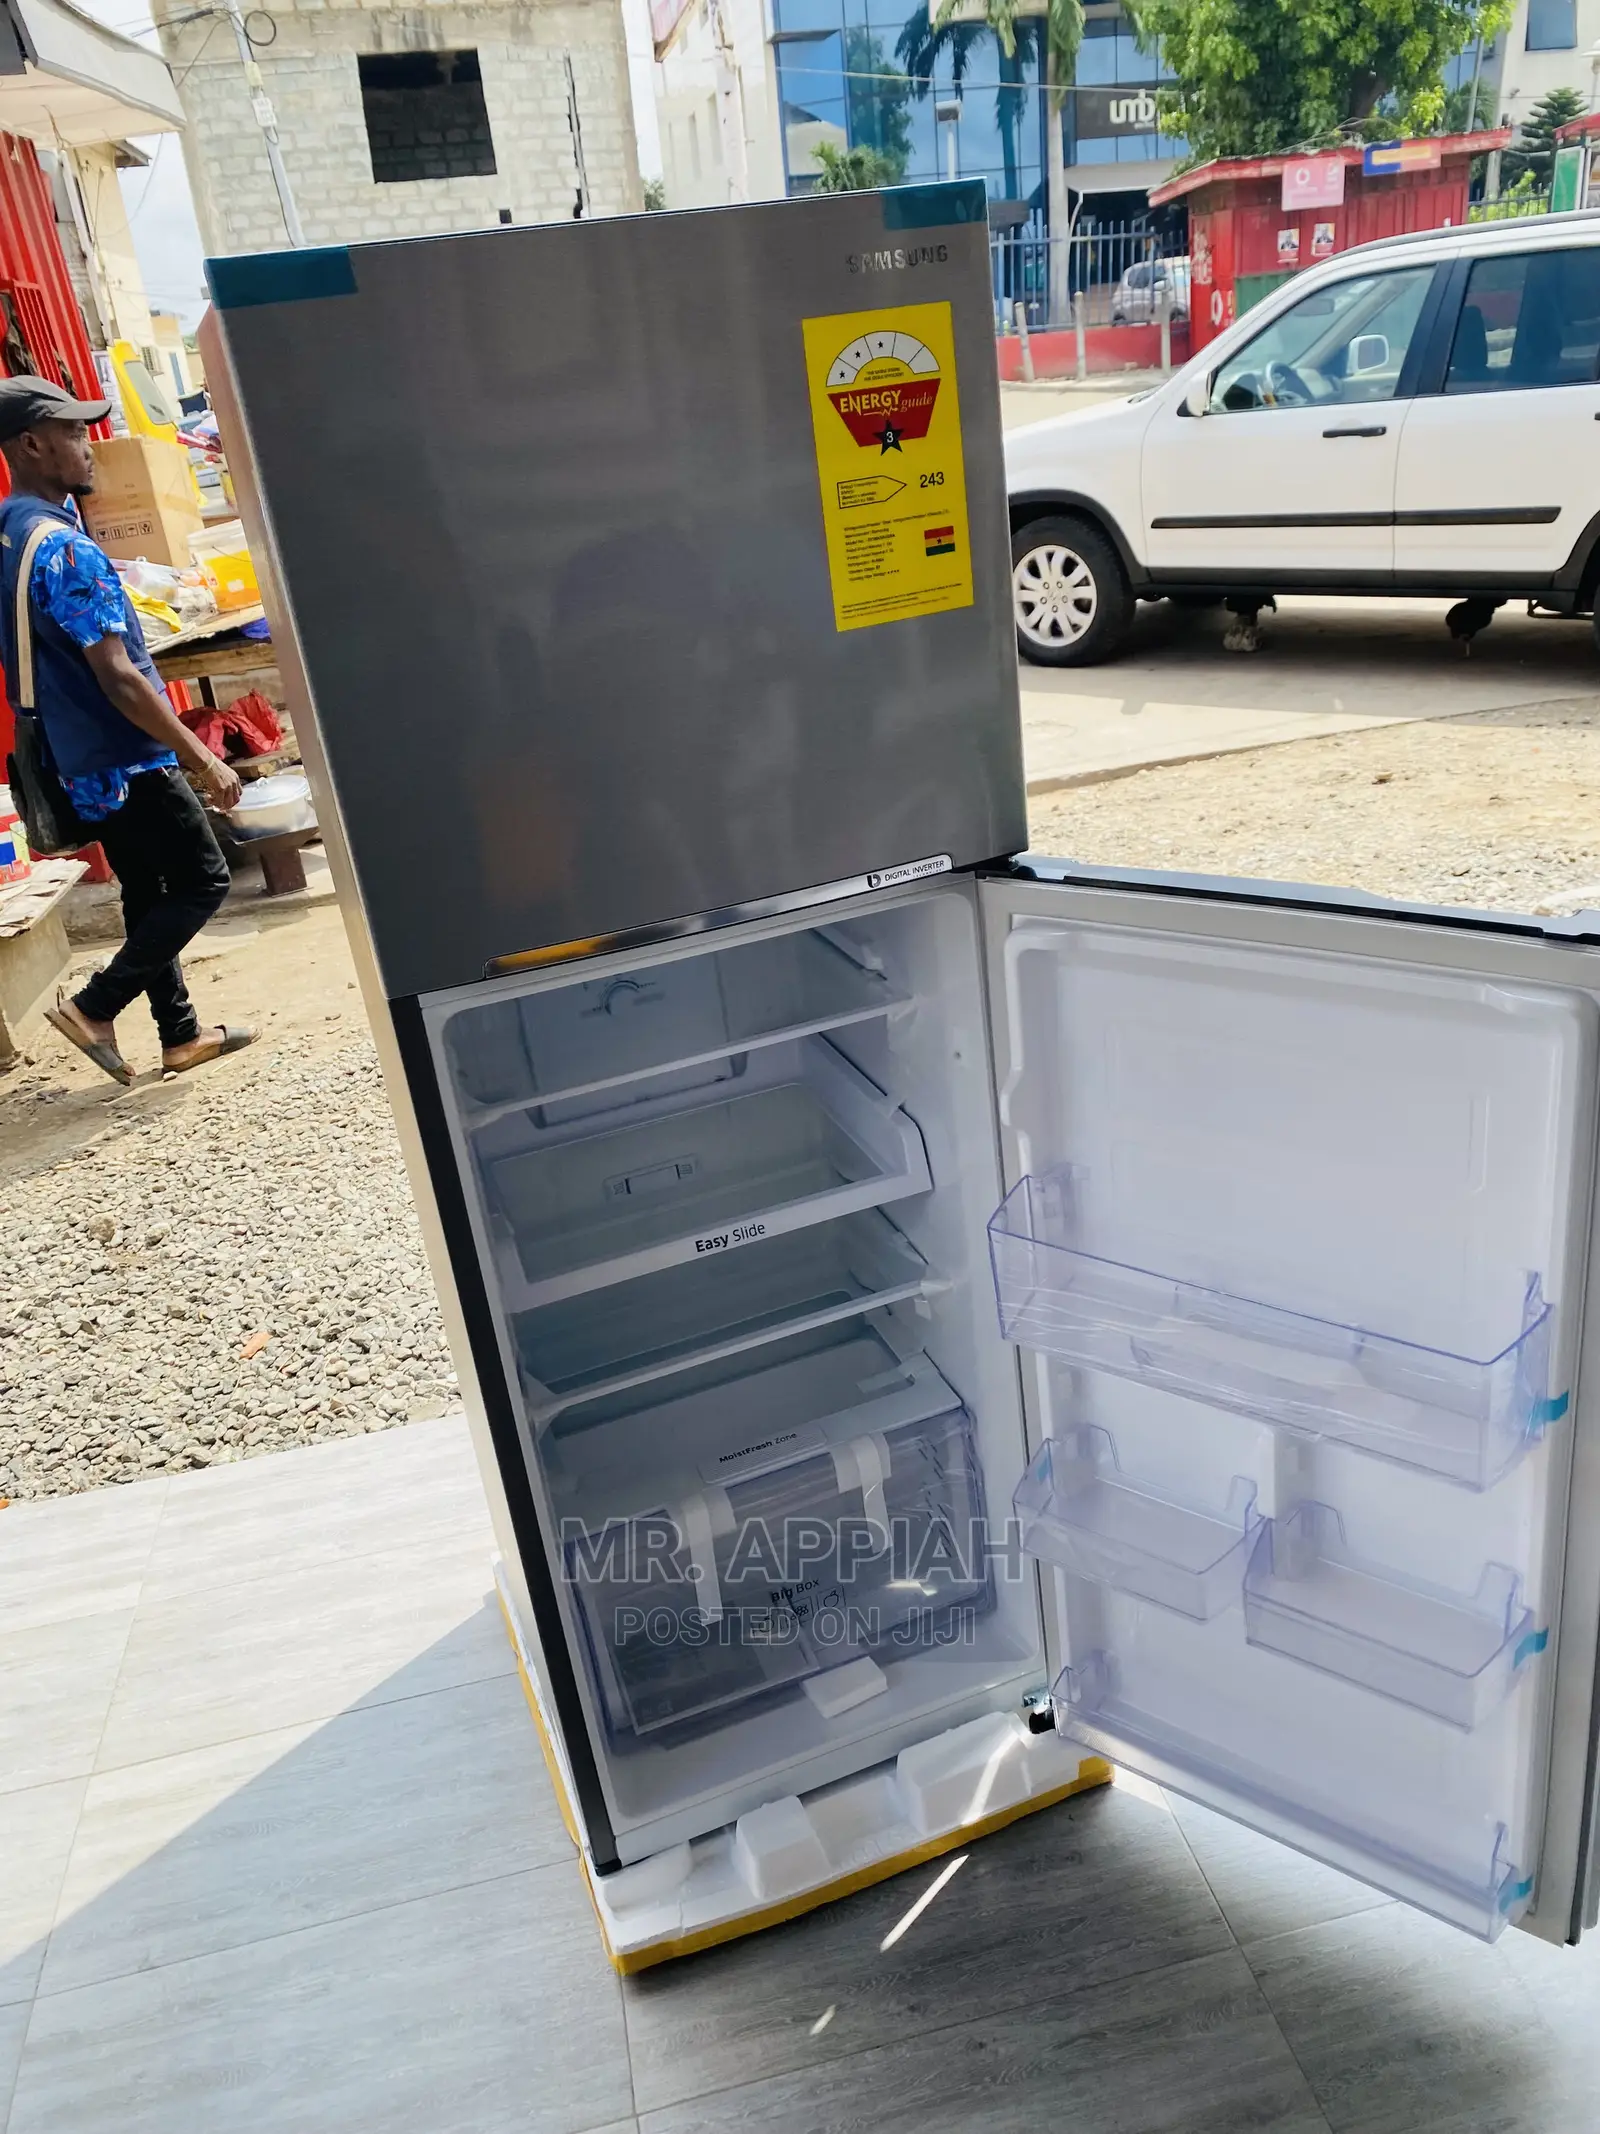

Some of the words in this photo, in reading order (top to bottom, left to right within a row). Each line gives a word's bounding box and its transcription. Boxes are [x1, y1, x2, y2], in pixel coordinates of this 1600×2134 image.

[846, 244, 949, 275] SAMSUNG
[839, 390, 902, 416] ENERGY
[901, 392, 933, 413] guide
[885, 431, 895, 443] 3
[919, 471, 945, 489] 243
[884, 870, 911, 882] DIGITAL
[912, 859, 945, 874] INVERTER
[695, 1234, 729, 1252] Easy
[732, 1223, 766, 1242] Slide
[719, 1441, 773, 1463] MoistFresh
[774, 1432, 797, 1445] Zone
[770, 1586, 793, 1603] Big
[795, 1578, 820, 1594] Box
